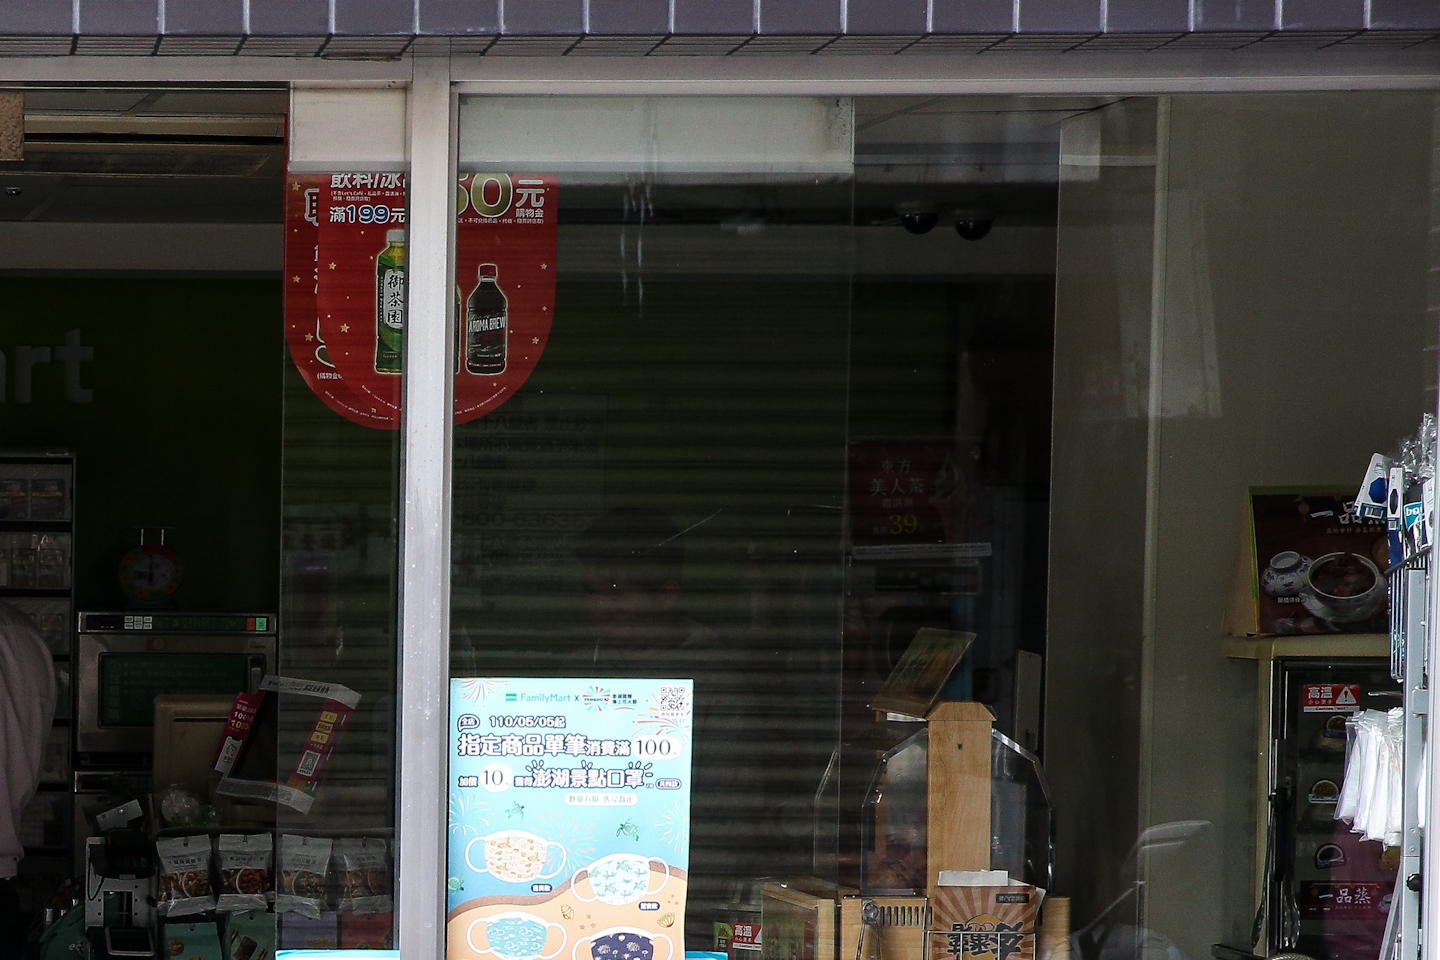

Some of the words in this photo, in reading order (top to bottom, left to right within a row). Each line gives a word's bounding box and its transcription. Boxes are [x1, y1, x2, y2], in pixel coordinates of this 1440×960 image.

[330, 204, 405, 224] 滿199元
[516, 208, 544, 218] 購物金
[881, 460, 911, 474] 東方
[870, 478, 925, 495] 美人茶
[890, 514, 918, 534] 39
[521, 693, 570, 703] FamilyMart
[1308, 687, 1332, 698] 高溫
[490, 716, 566, 728] 110/05/05起
[458, 733, 631, 756] 指定商品單筆消費滿
[1319, 887, 1371, 904] 一品蒸
[735, 925, 752, 937] 高溫
